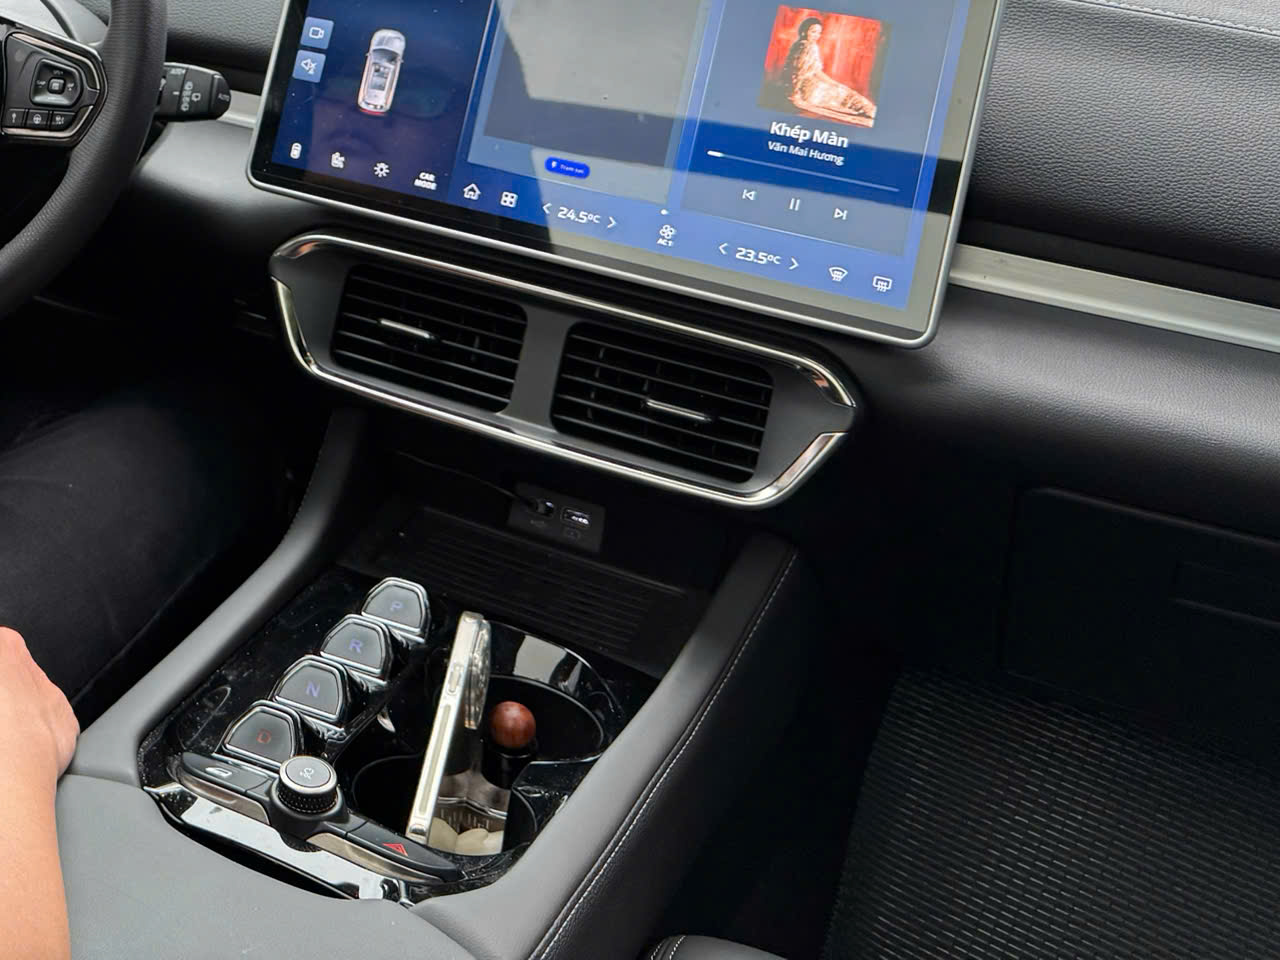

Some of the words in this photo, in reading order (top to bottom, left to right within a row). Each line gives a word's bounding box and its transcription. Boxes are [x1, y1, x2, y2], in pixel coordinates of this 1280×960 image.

[770, 121, 811, 142] Khép
[789, 145, 808, 157] Mai
[349, 639, 364, 653] R
[306, 681, 321, 698] N
